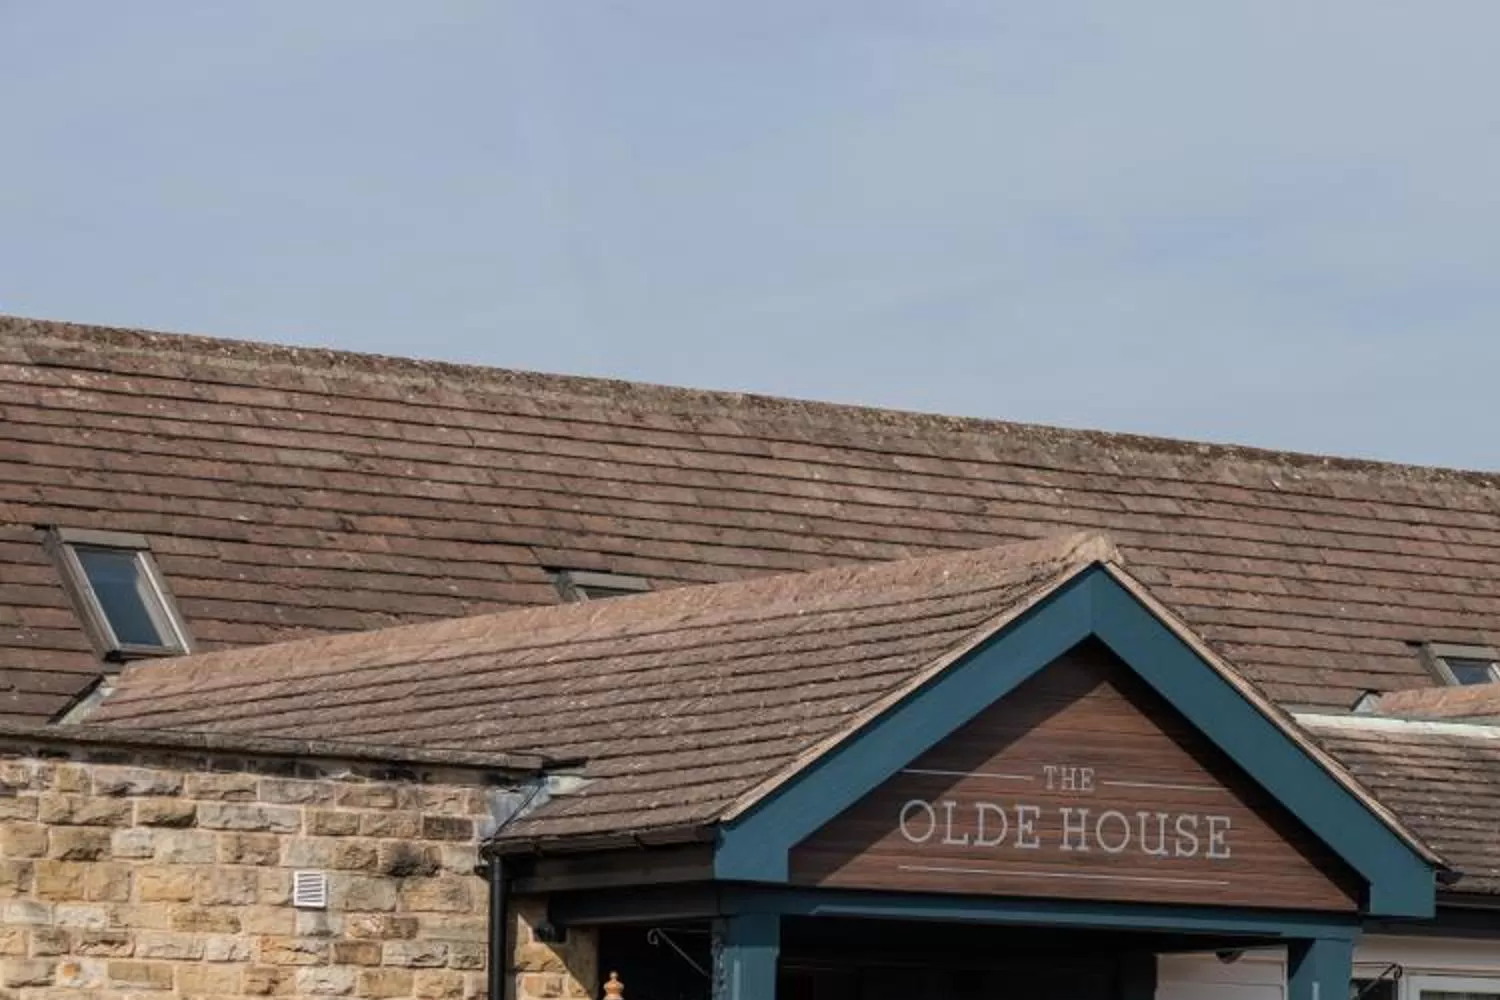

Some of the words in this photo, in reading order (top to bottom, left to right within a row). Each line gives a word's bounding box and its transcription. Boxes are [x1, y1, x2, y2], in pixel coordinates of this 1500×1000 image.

[1043, 765, 1095, 792] THE
[900, 799, 1041, 850] OLDE
[1060, 807, 1232, 859] HOUSE
